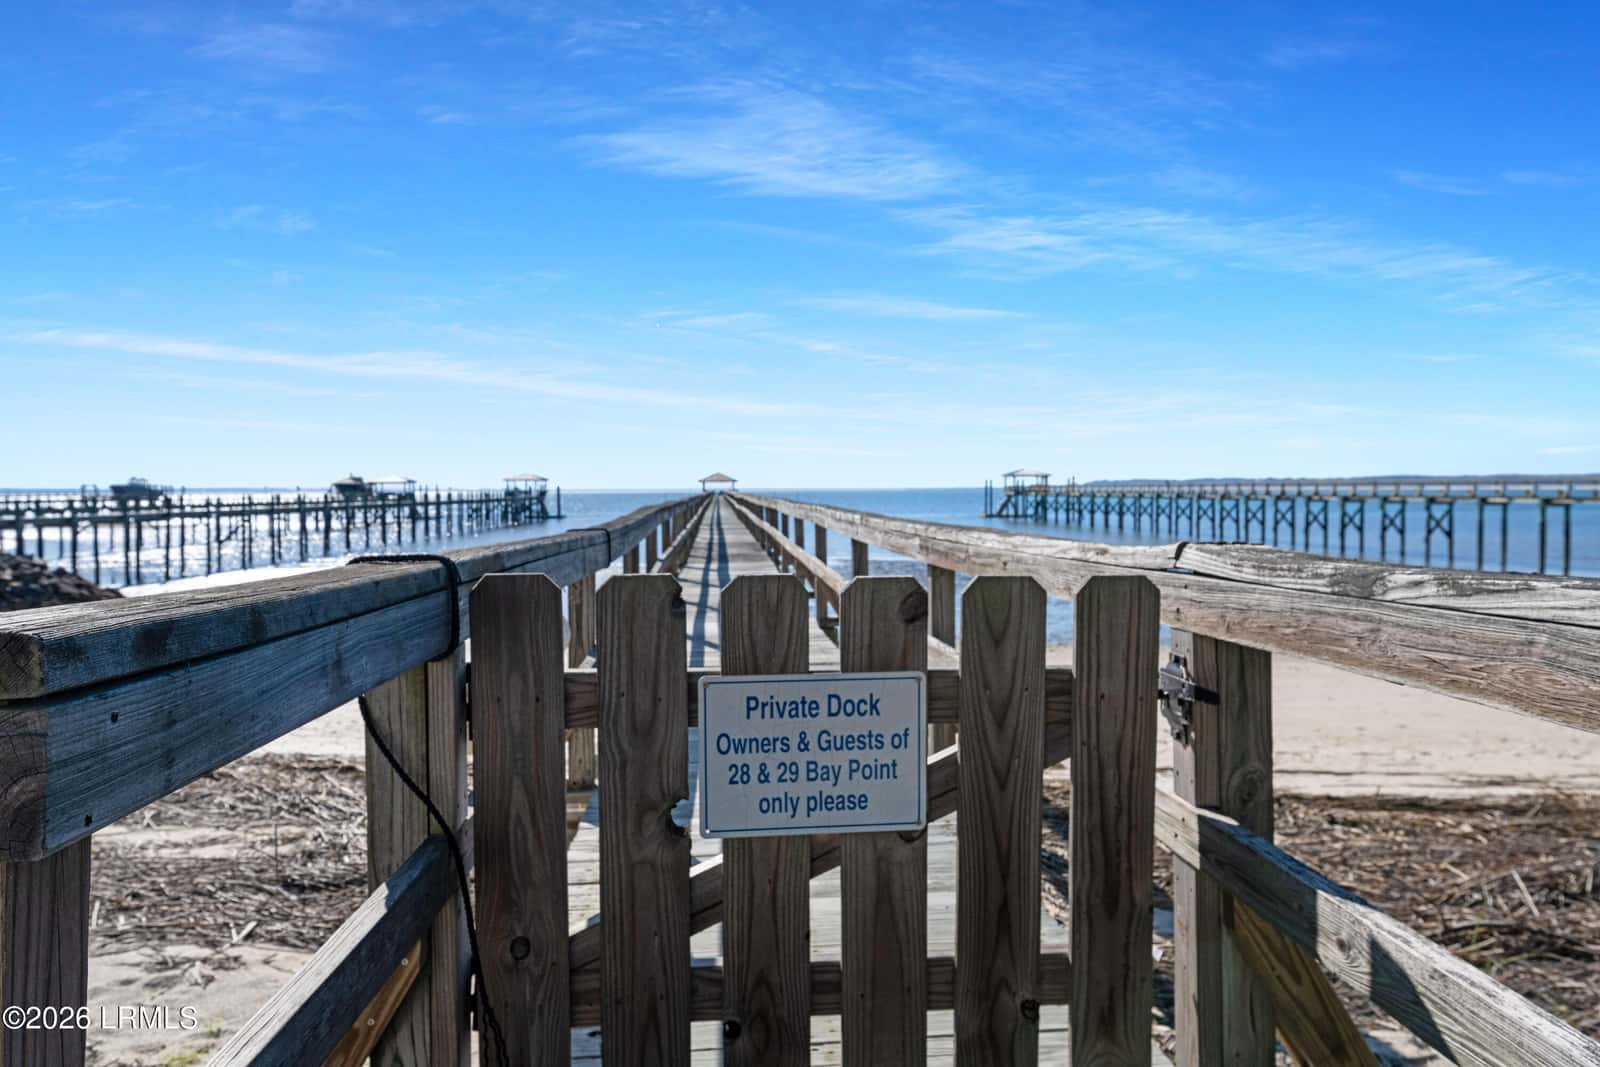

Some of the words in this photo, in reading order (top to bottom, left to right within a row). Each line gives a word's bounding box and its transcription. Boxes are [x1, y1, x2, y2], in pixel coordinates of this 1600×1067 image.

[745, 695, 820, 720] Private
[827, 692, 881, 718] Dock
[716, 732, 791, 755] Owners
[797, 730, 810, 753] &
[817, 729, 885, 752] Guests
[890, 728, 910, 750] of
[728, 762, 751, 785] 28
[757, 762, 770, 784] &
[777, 761, 799, 783] 29
[806, 760, 842, 787] Bay
[848, 758, 898, 781] Point
[758, 791, 800, 819] only
[806, 789, 869, 818] please
